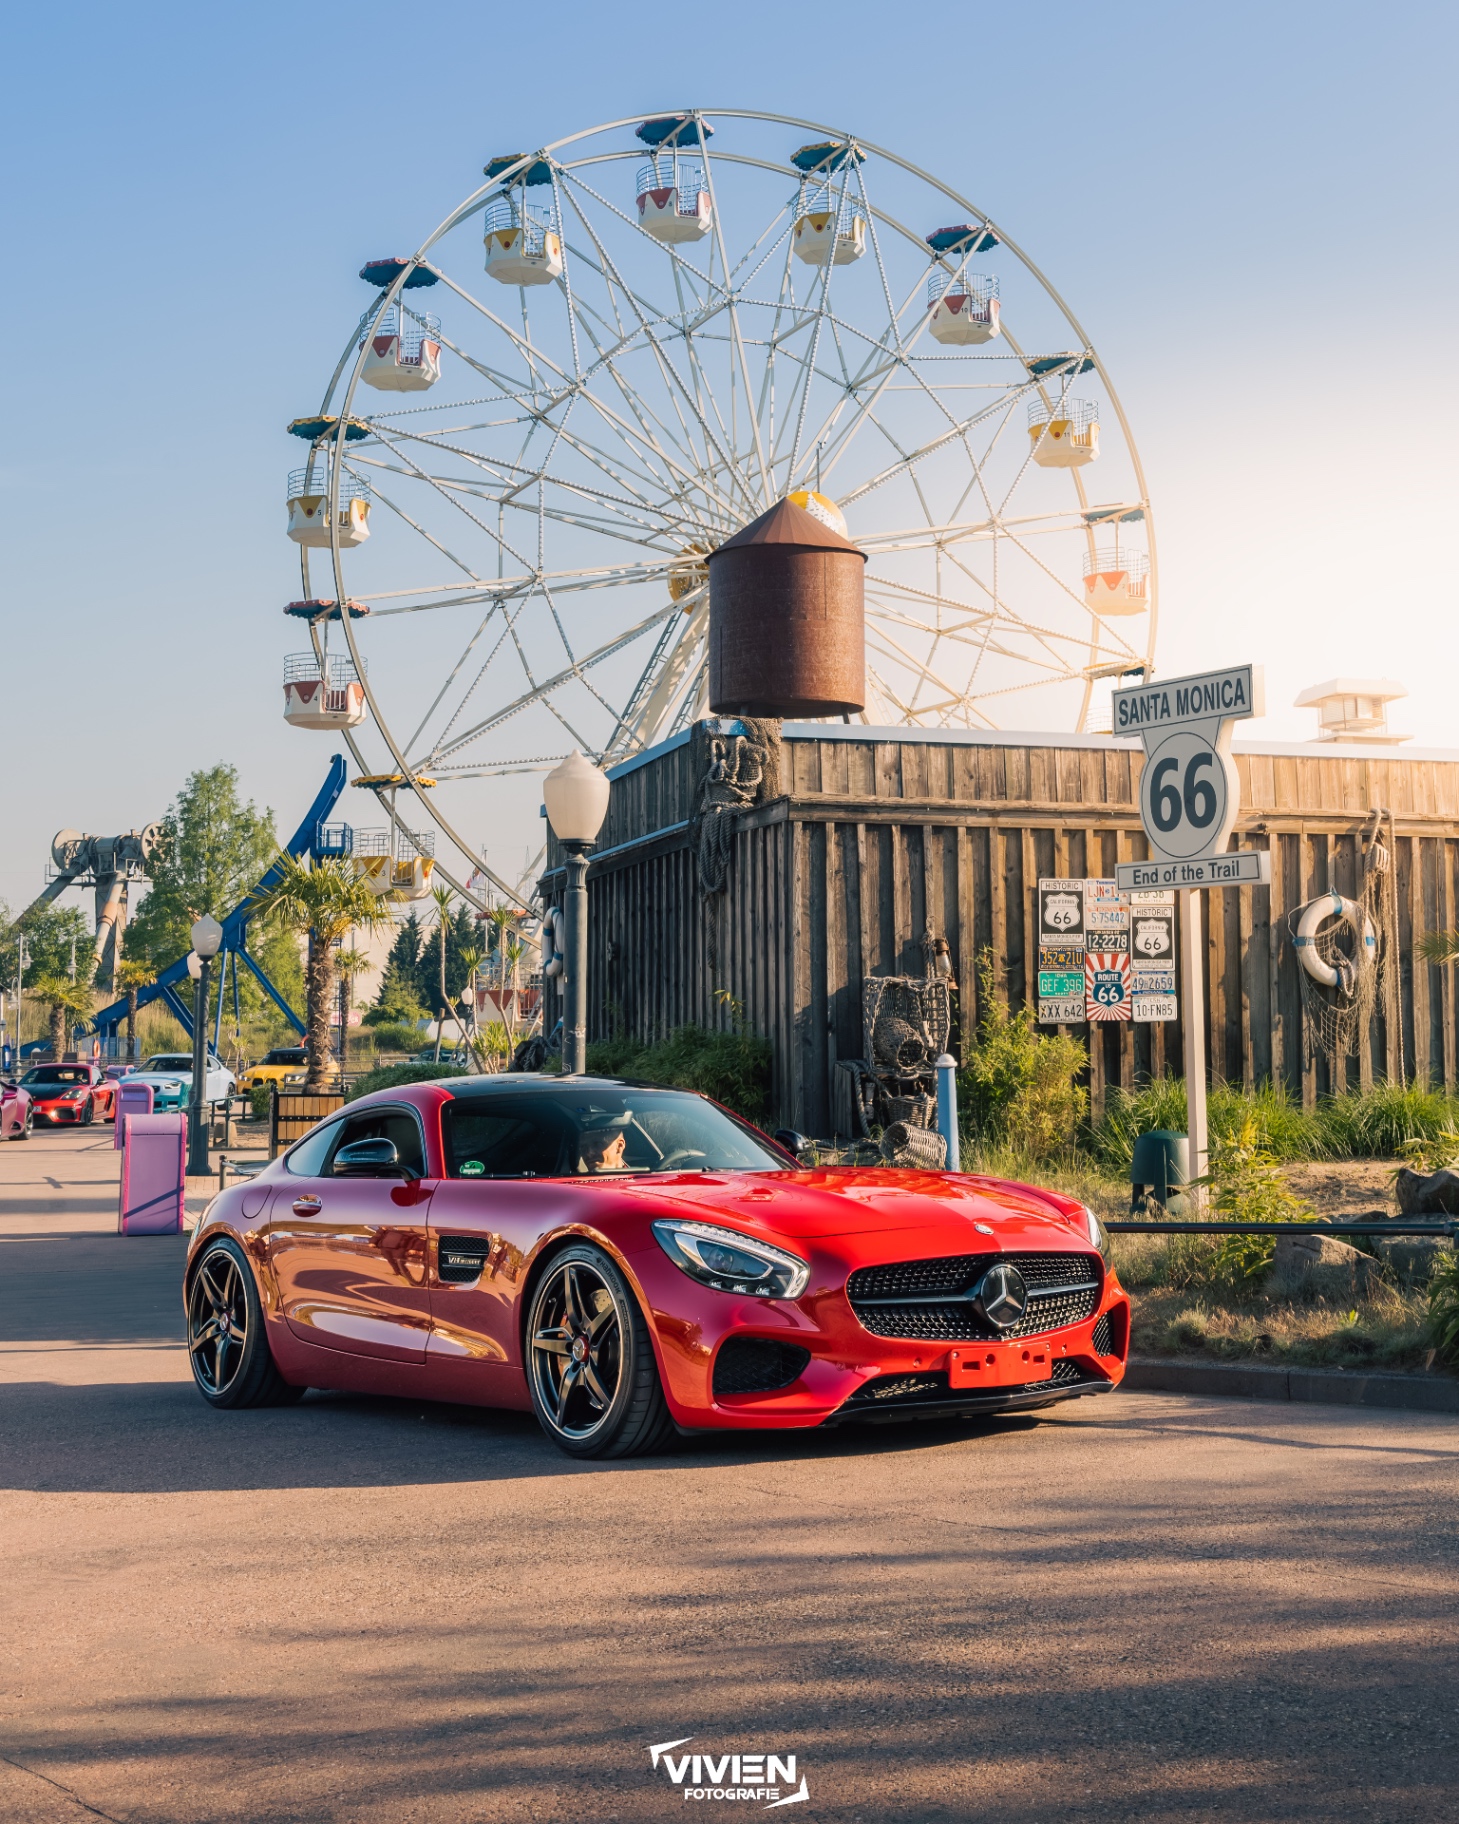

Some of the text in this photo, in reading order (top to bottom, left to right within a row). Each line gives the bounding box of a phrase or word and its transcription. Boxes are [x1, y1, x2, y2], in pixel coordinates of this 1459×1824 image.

[1118, 677, 1246, 727] SANTA MONICA
[1150, 752, 1217, 832] 66
[1133, 860, 1240, 885] End of the Trail
[1045, 882, 1079, 890] HISTORIC
[1053, 911, 1072, 925] 66
[1136, 908, 1168, 916] HISTORIC
[1088, 934, 1128, 949] 12-2278
[1144, 937, 1162, 951] 66
[1041, 951, 1058, 965] 352
[1097, 973, 1119, 981] ROUTE
[1041, 978, 1082, 992] GEF 396
[1097, 986, 1120, 1003] 66
[1064, 1004, 1083, 1018] 642
